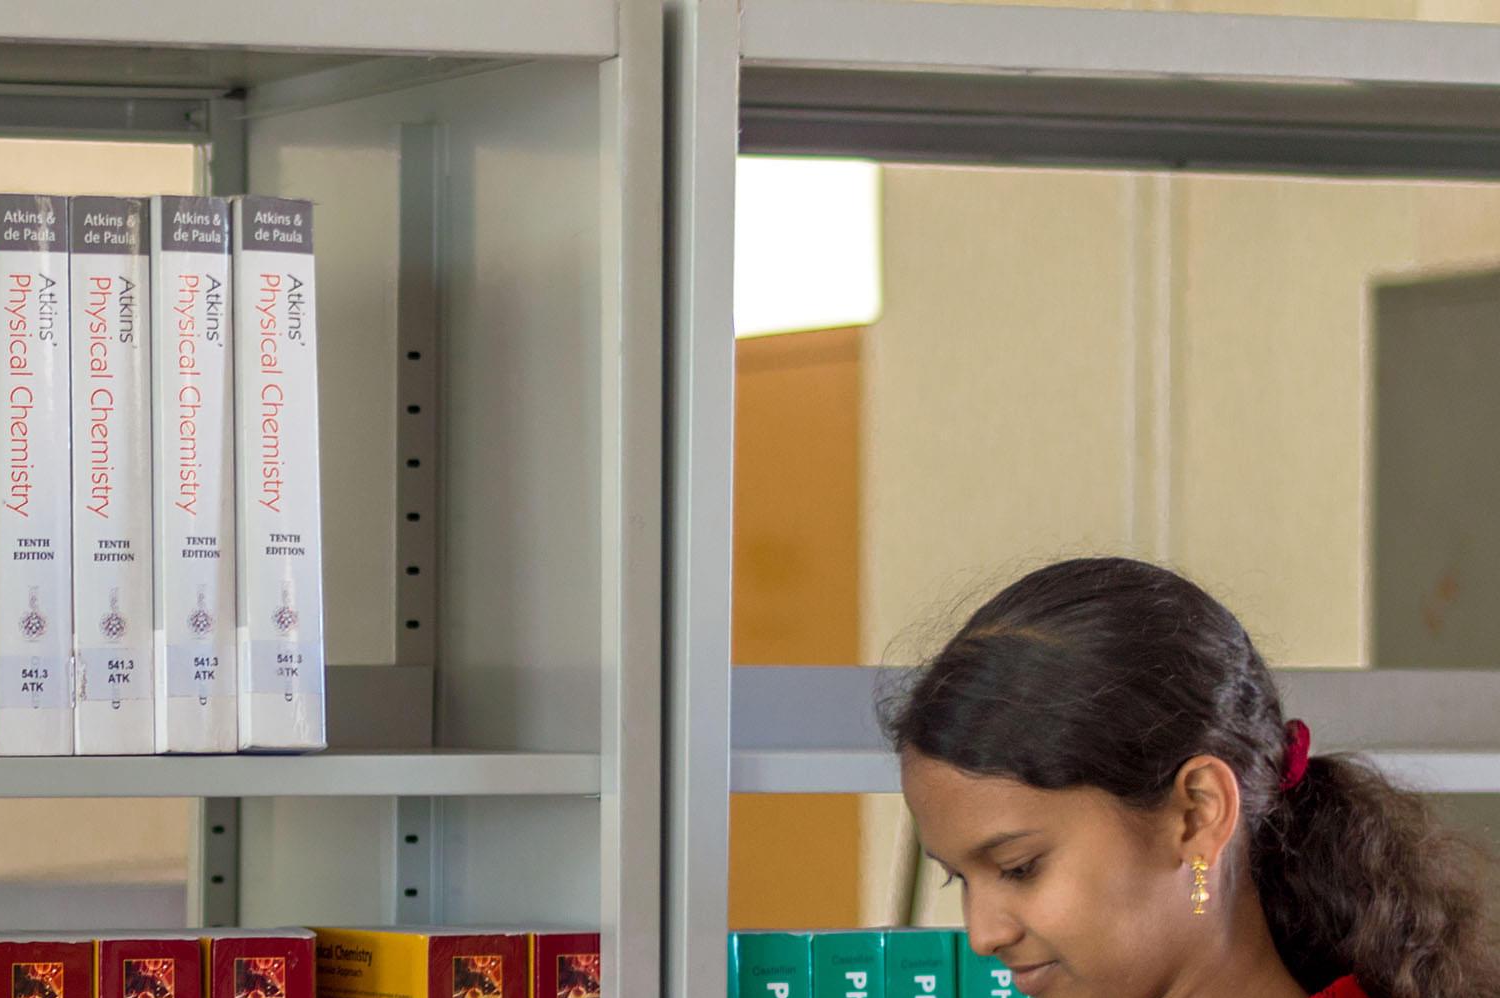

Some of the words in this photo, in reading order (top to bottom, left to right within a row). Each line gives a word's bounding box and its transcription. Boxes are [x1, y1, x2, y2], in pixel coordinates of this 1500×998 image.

[254, 211, 289, 225] Atkins
[293, 212, 302, 226] &
[255, 228, 271, 241] de
[275, 229, 302, 243] Paula
[3, 273, 33, 377] Physical
[256, 273, 284, 375] Physical
[5, 385, 35, 517] Chemistry
[259, 383, 285, 513] Chemistry
[182, 550, 221, 559] EDITION
[186, 537, 217, 546] TENTH
